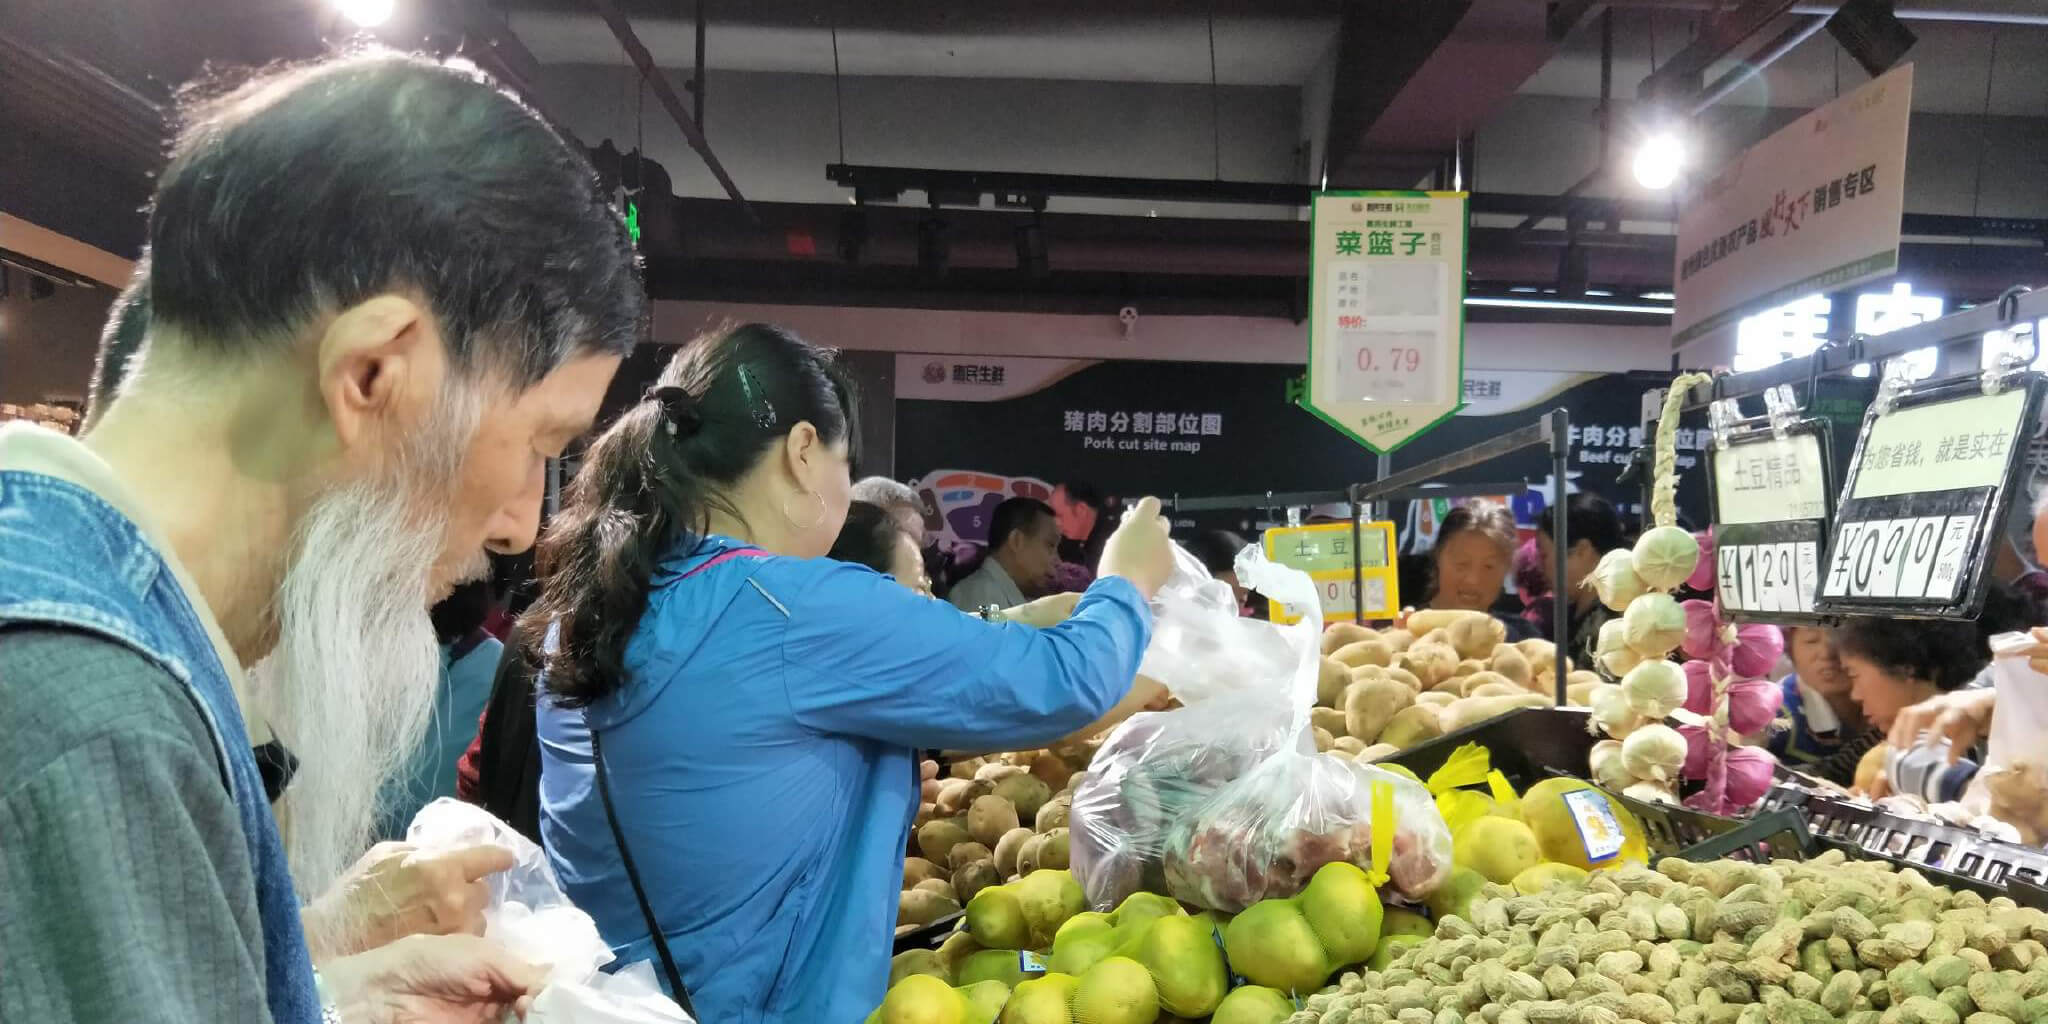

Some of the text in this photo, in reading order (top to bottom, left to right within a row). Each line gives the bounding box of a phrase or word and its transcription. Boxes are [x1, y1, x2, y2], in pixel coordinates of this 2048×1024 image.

[1335, 230, 1427, 256] 菜篮子
[1357, 348, 1420, 372] 0.79
[1064, 410, 1222, 435] 猪肉分割部位图
[1084, 436, 1200, 454] Pork cut site map
[1579, 450, 1611, 463] Beef
[1735, 454, 1801, 491] 土豆精品
[972, 515, 981, 528] 5
[1295, 538, 1348, 556] 土豆
